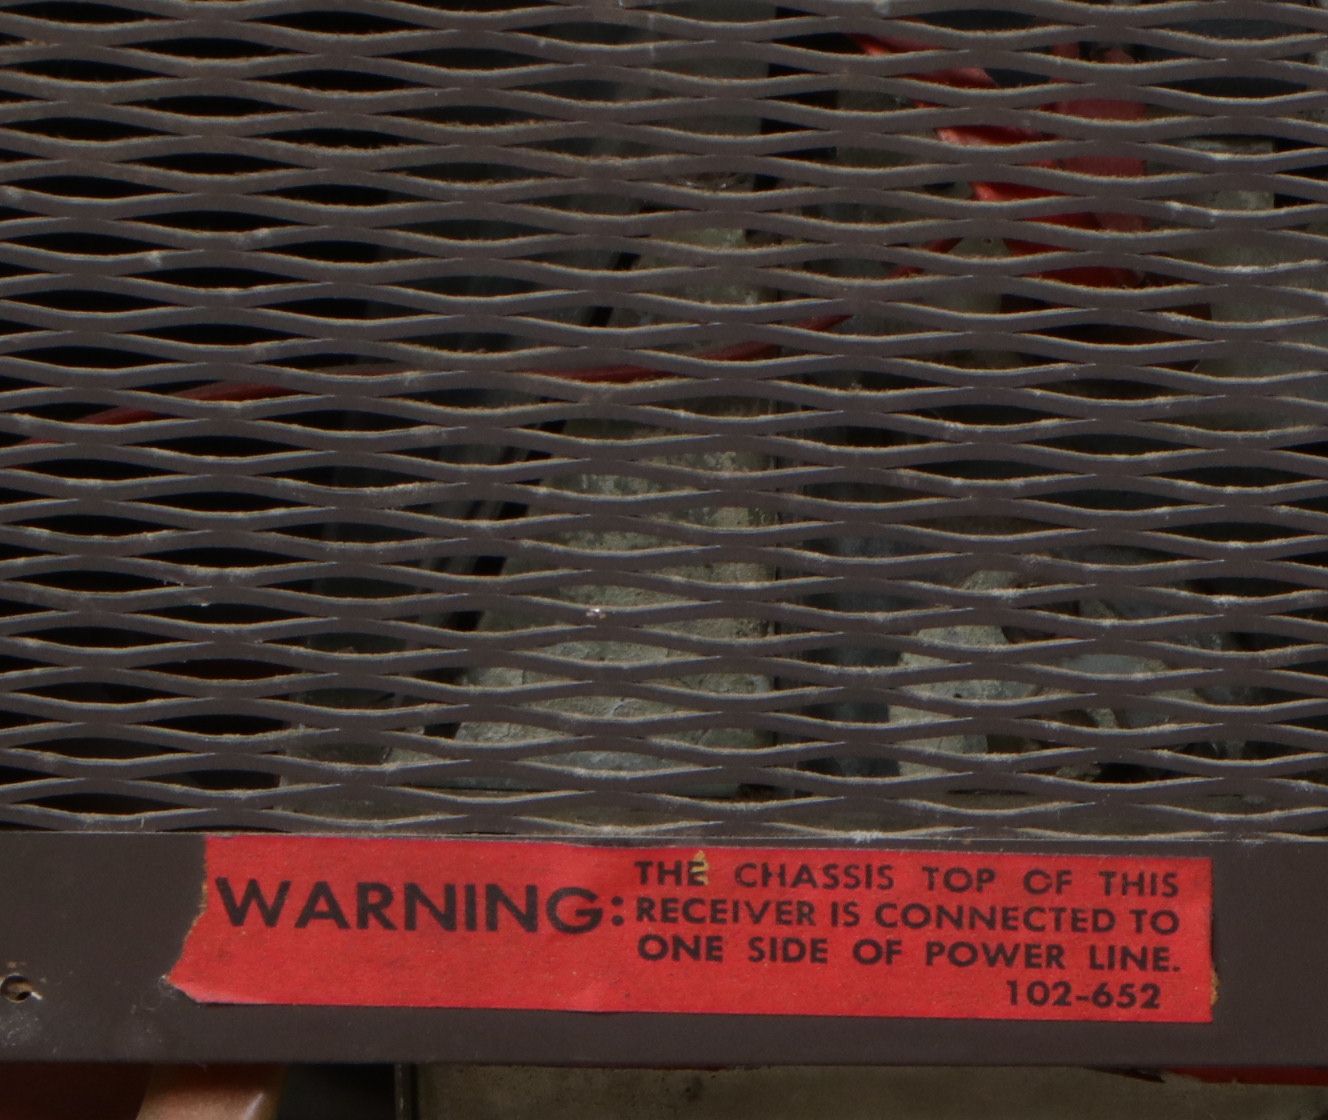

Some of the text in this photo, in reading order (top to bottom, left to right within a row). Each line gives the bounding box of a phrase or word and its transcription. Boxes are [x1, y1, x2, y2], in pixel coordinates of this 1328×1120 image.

[634, 860, 1180, 898] THE CHASSIS TOP OF THIS
[215, 876, 625, 935] WARNING:
[635, 897, 1181, 936] RECEIVER IS CONNECTED TO
[637, 933, 1182, 973] ONE SIDE OF POWER LINE.
[1006, 979, 1162, 1010] 102-652
